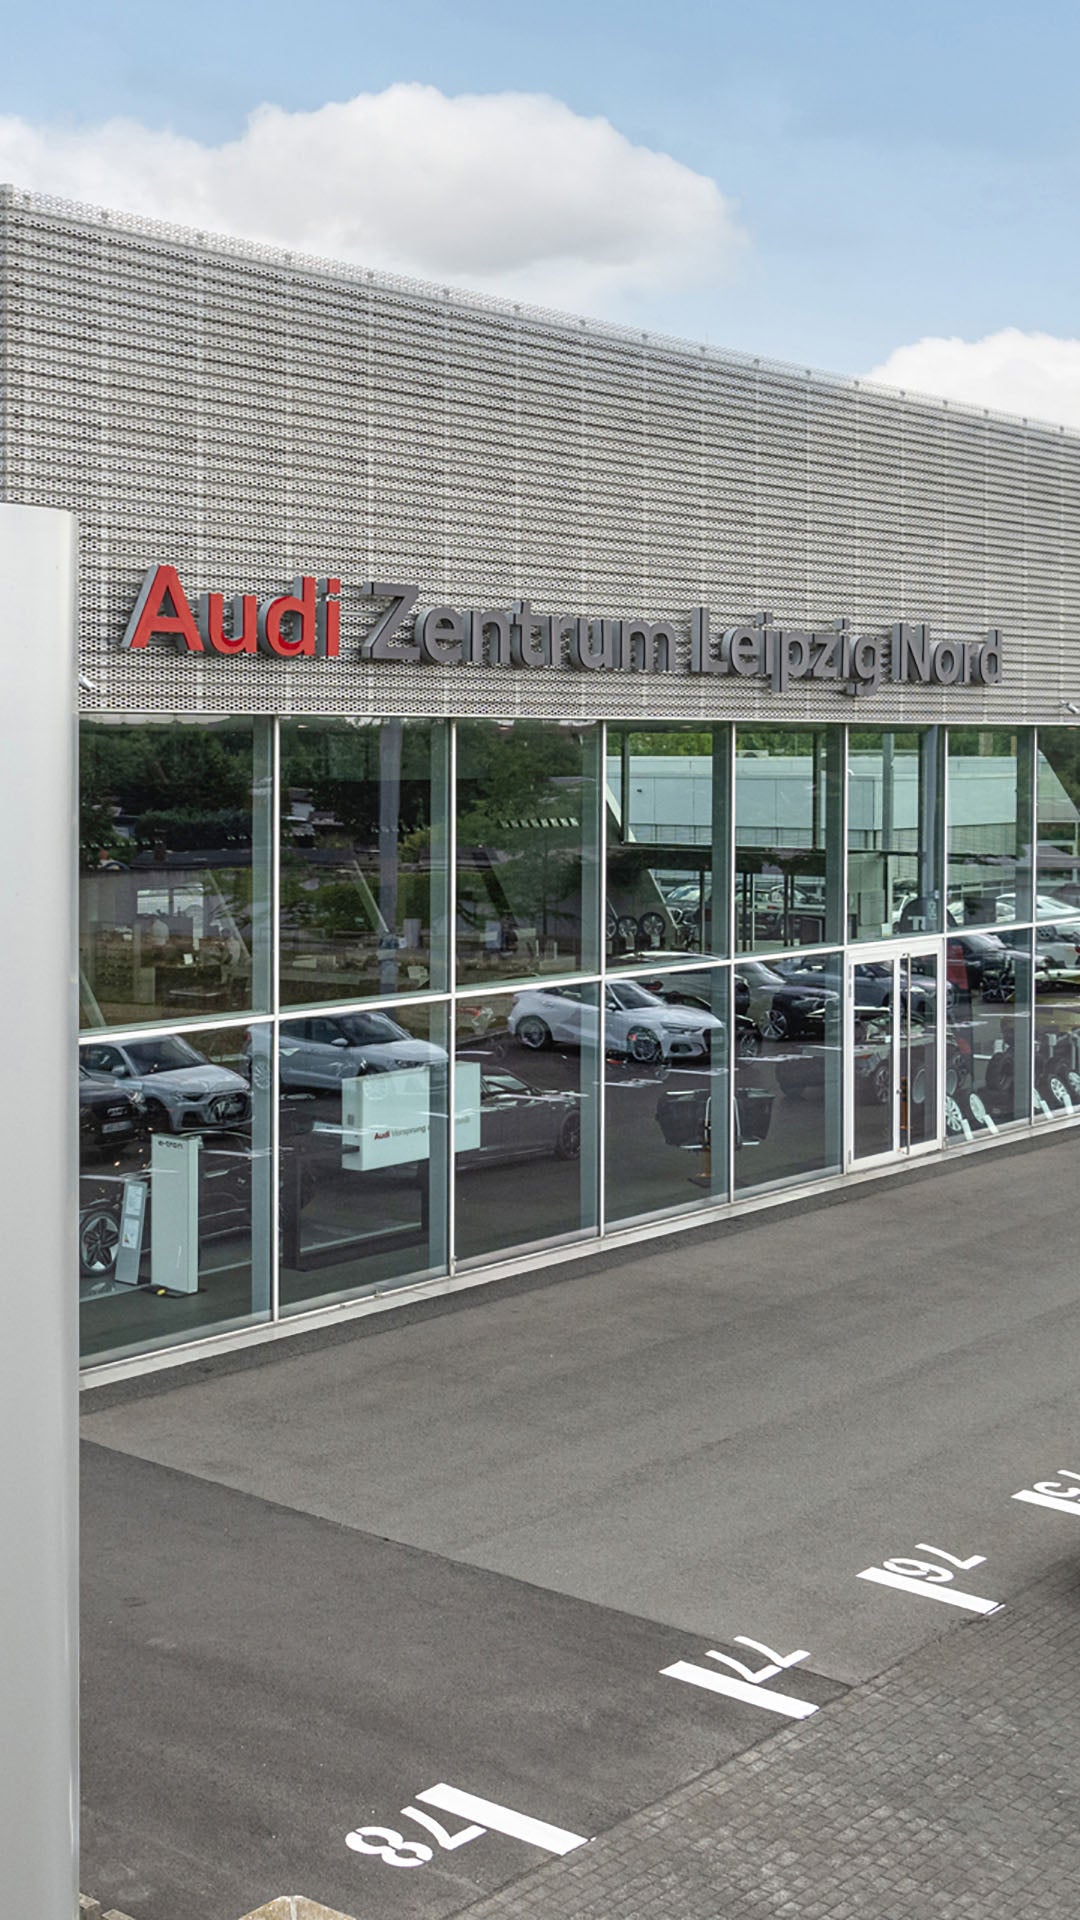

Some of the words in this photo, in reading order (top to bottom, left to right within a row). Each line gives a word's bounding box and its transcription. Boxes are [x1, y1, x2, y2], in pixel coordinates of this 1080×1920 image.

[122, 564, 341, 658] Audi
[359, 581, 676, 671] Zentrum
[690, 606, 883, 696] Leipzig
[892, 622, 1002, 684] Nord
[374, 1129, 391, 1140] Audi
[883, 1543, 988, 1583] 76
[705, 1636, 811, 1683] 77
[345, 1806, 487, 1867] 78
